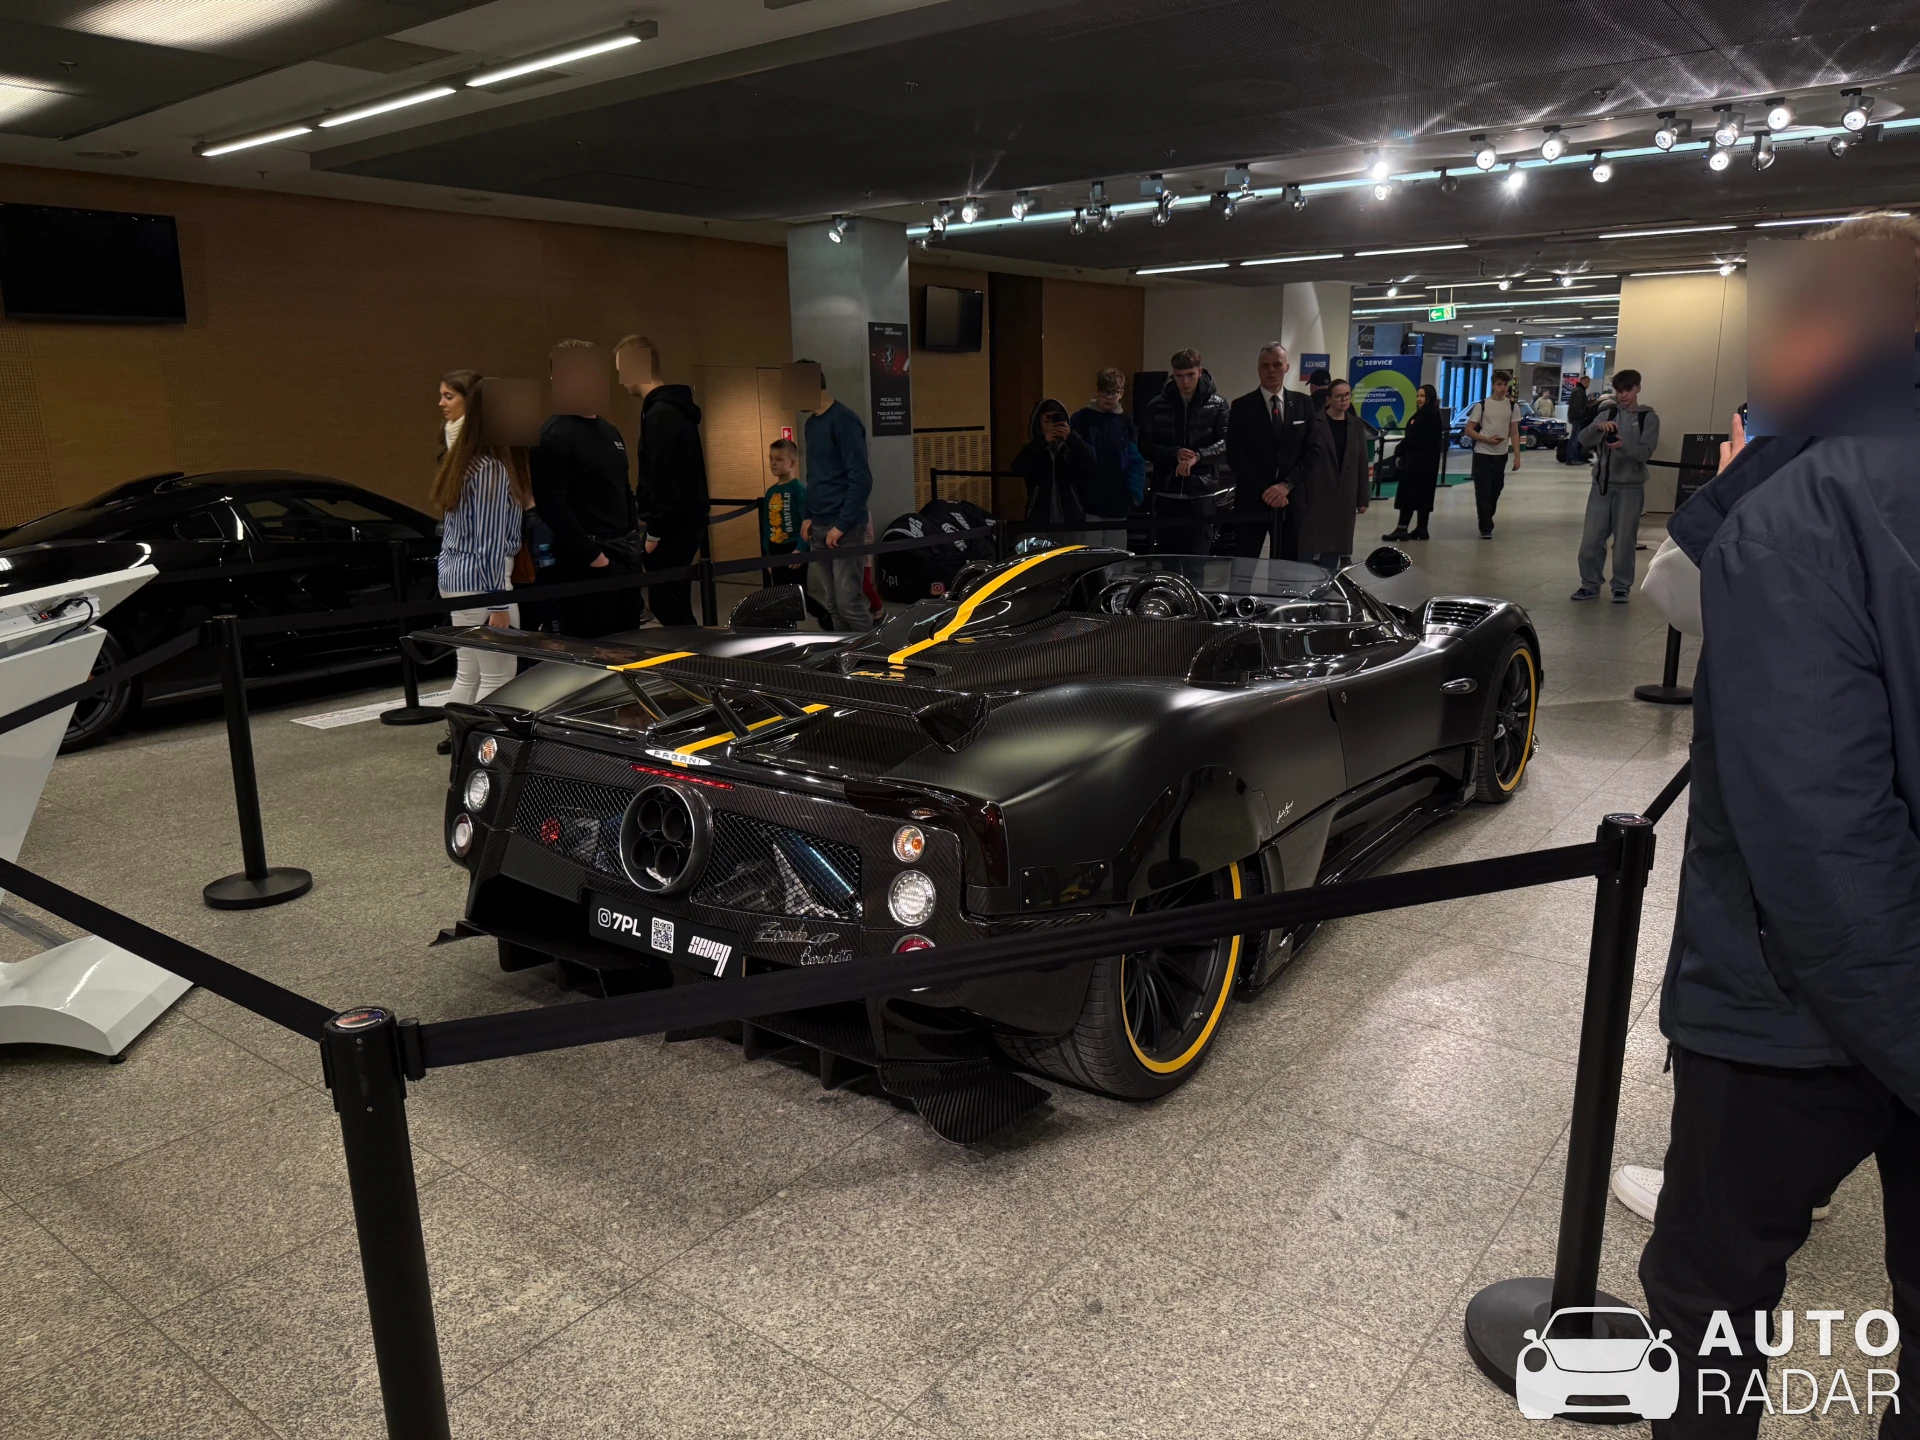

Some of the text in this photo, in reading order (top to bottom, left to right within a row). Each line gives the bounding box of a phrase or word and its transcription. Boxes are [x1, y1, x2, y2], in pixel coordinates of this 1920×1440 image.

[653, 751, 701, 766] PAGANI
[612, 913, 642, 937] 7PL
[754, 921, 808, 943] Zonda
[800, 945, 854, 967] Barchetta
